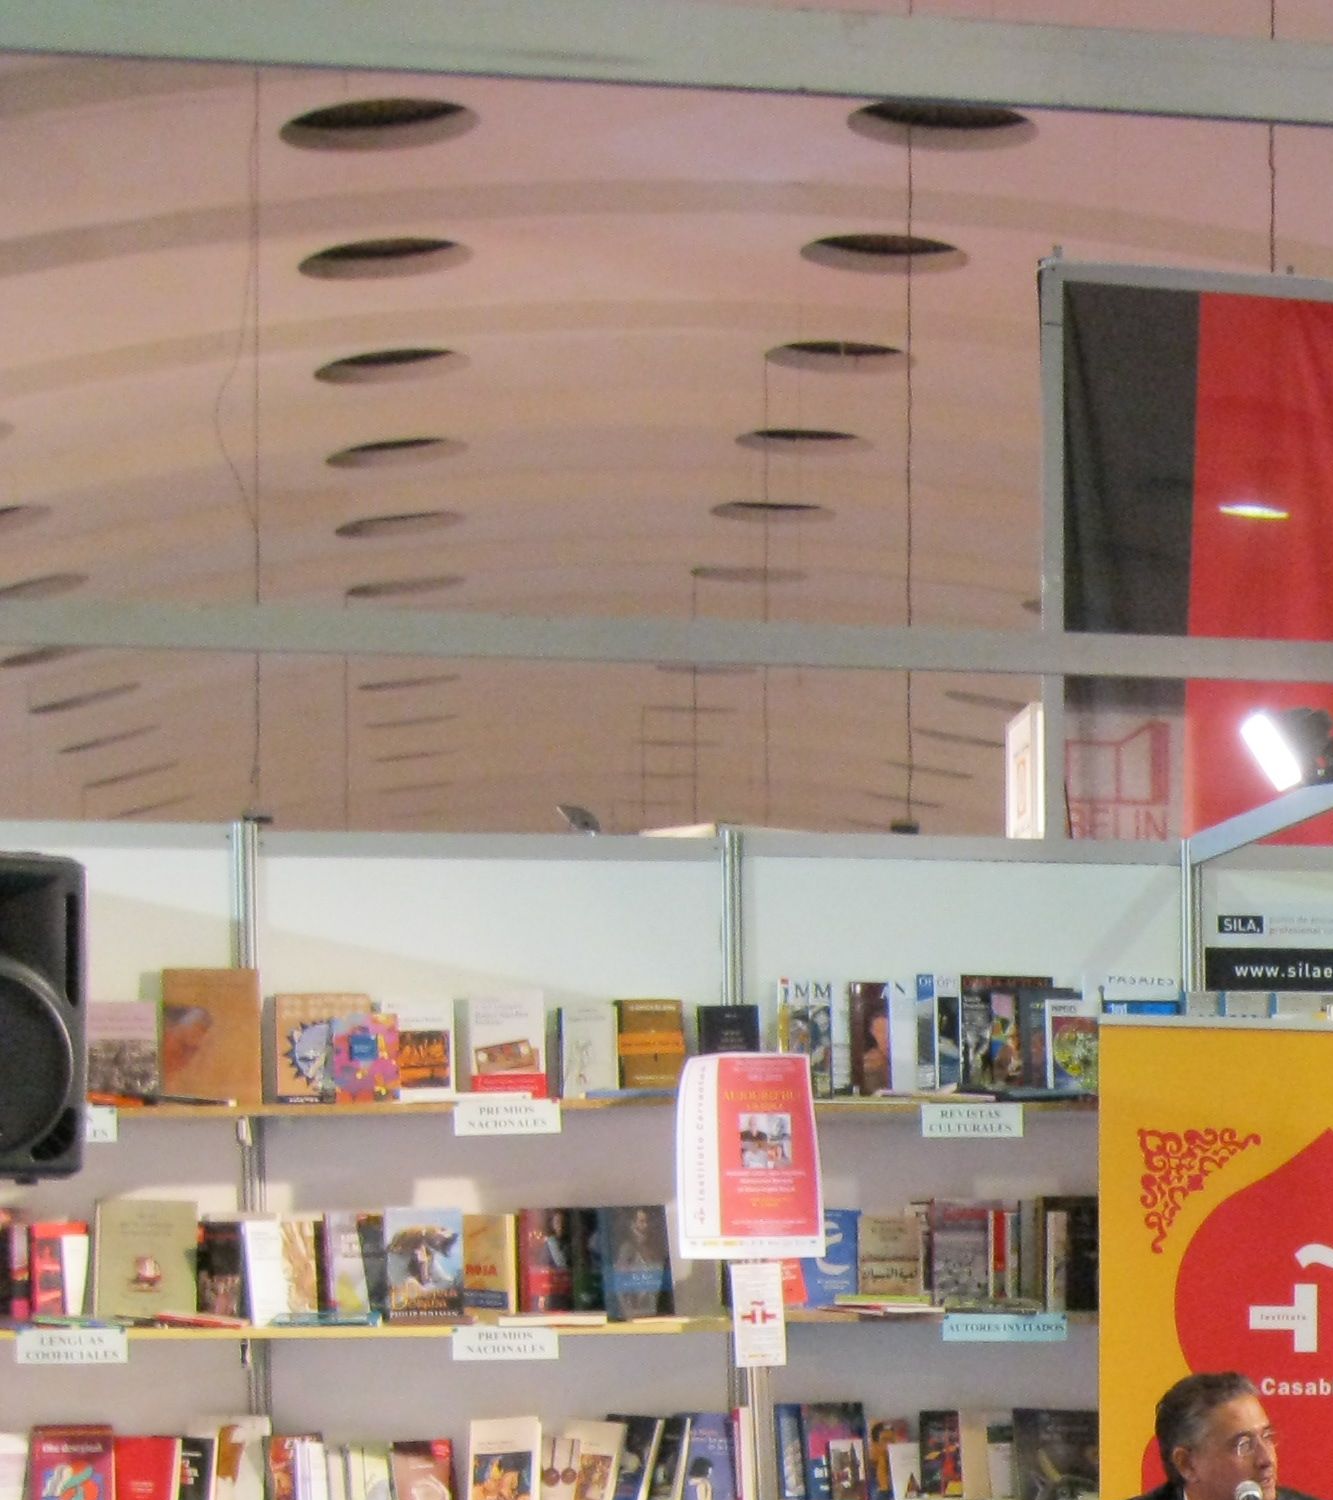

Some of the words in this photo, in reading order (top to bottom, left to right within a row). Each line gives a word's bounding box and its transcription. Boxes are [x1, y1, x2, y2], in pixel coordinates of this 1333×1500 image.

[479, 1105, 535, 1116] PREMIOS
[940, 1108, 1001, 1119] REVISTAS
[478, 1331, 534, 1341] PREMIOS
